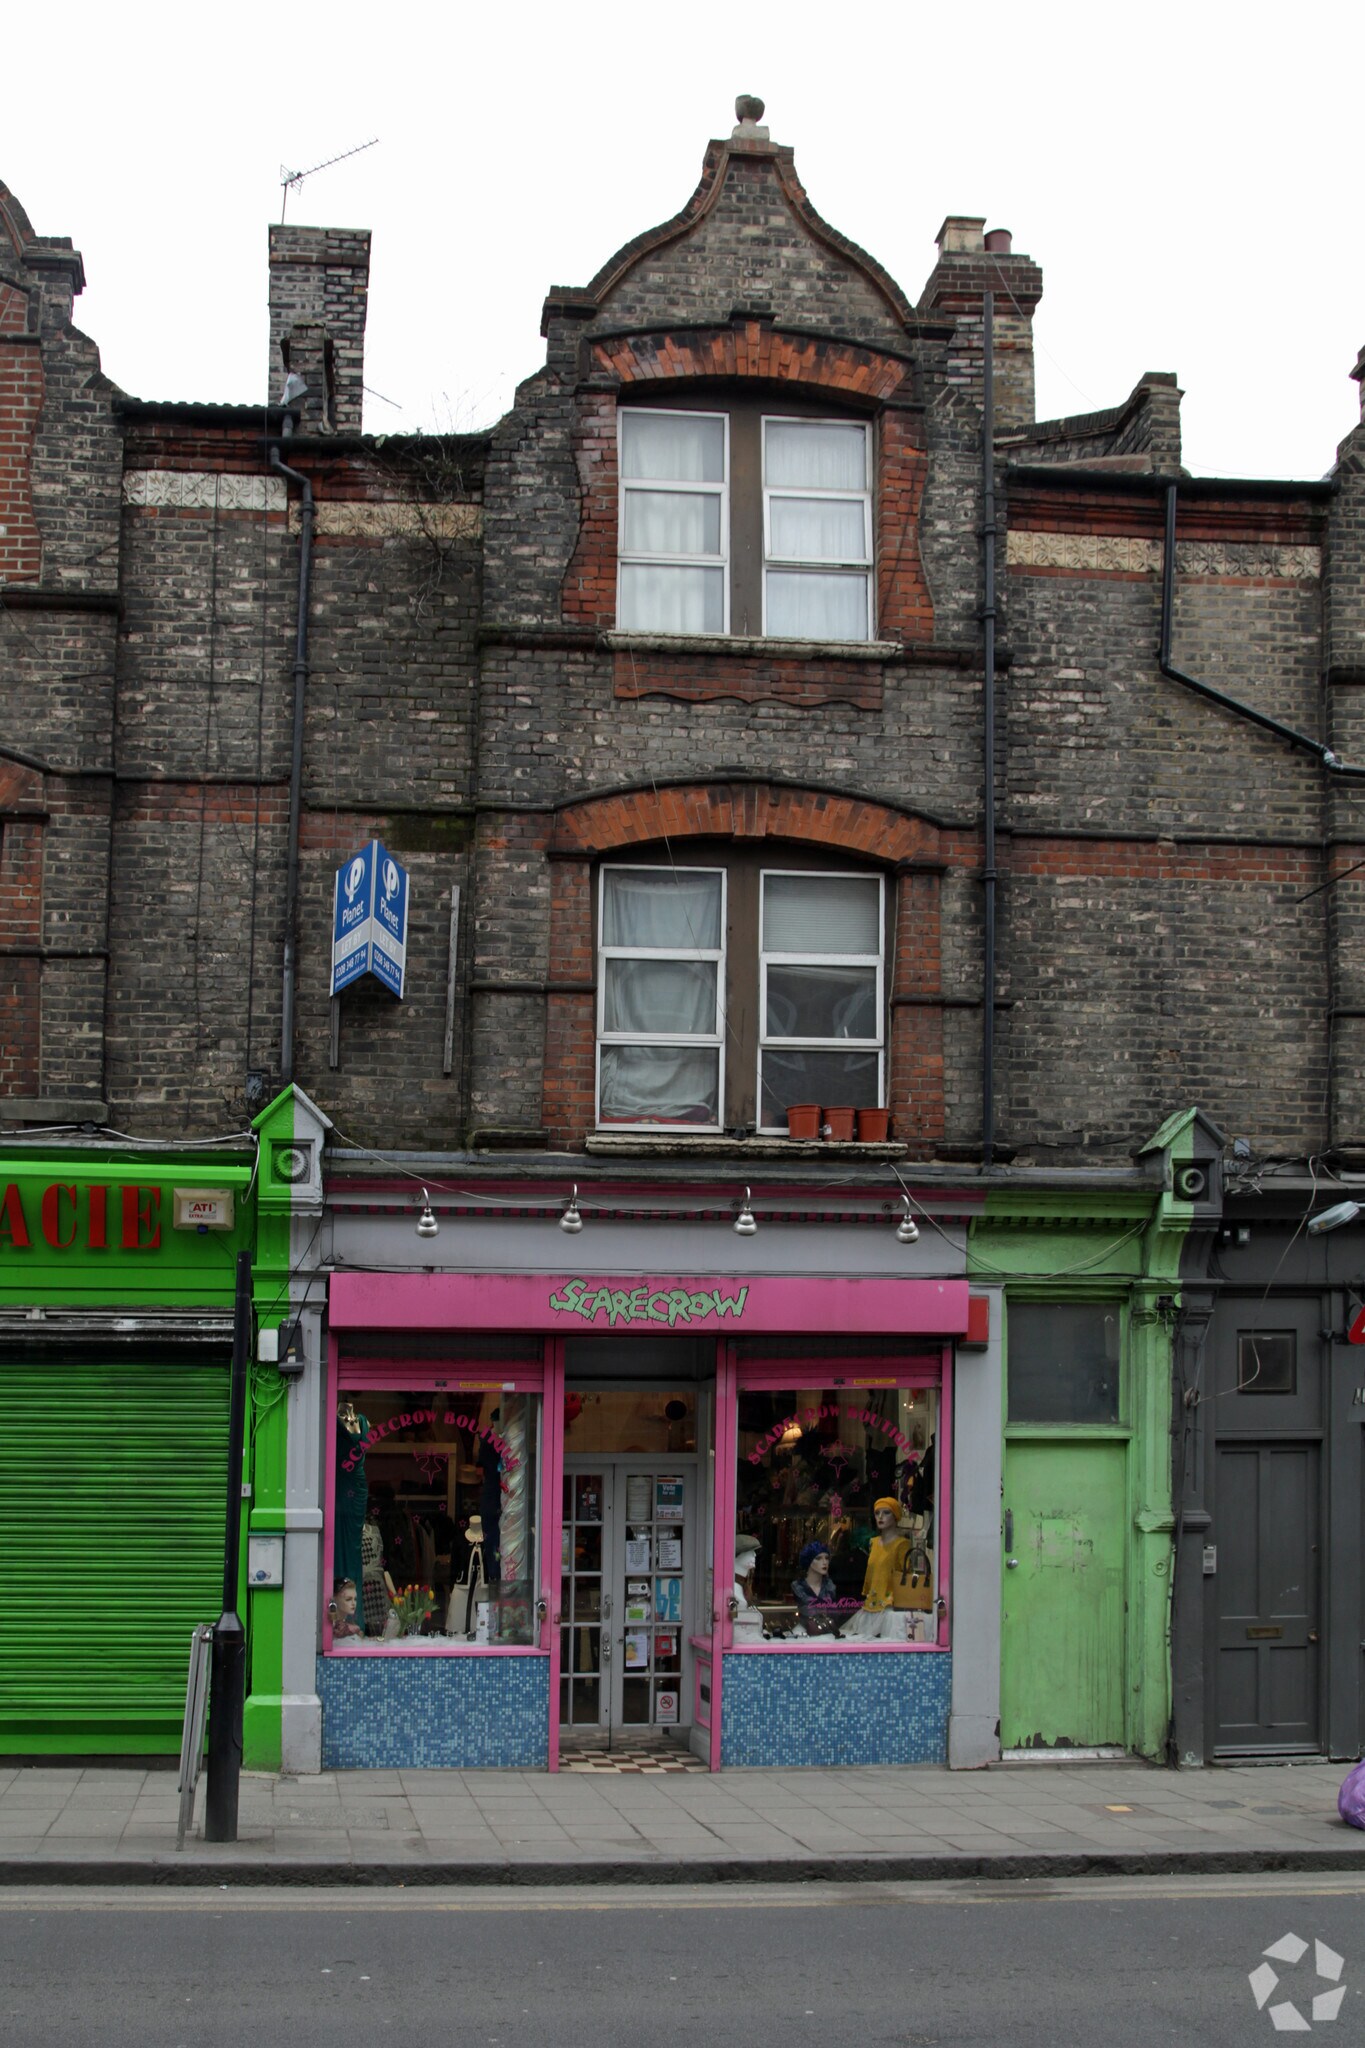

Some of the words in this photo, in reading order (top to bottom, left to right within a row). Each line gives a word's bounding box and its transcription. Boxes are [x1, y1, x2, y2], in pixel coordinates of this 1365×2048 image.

[342, 900, 364, 928] Planet
[380, 896, 399, 930] Planet
[341, 937, 352, 955] LET
[352, 930, 362, 945] BY
[379, 930, 389, 948] LET
[335, 963, 346, 979] 0208
[360, 948, 367, 961] 94
[0, 1182, 161, 1249] ACIE
[192, 1203, 213, 1212] ATI
[549, 1277, 750, 1327] SCARECROW
[340, 1409, 438, 1473] SCARECROW
[443, 1410, 522, 1473] BOUTIQUE
[747, 1403, 840, 1466] SCARECROW
[847, 1405, 923, 1466] BOUTIQUE
